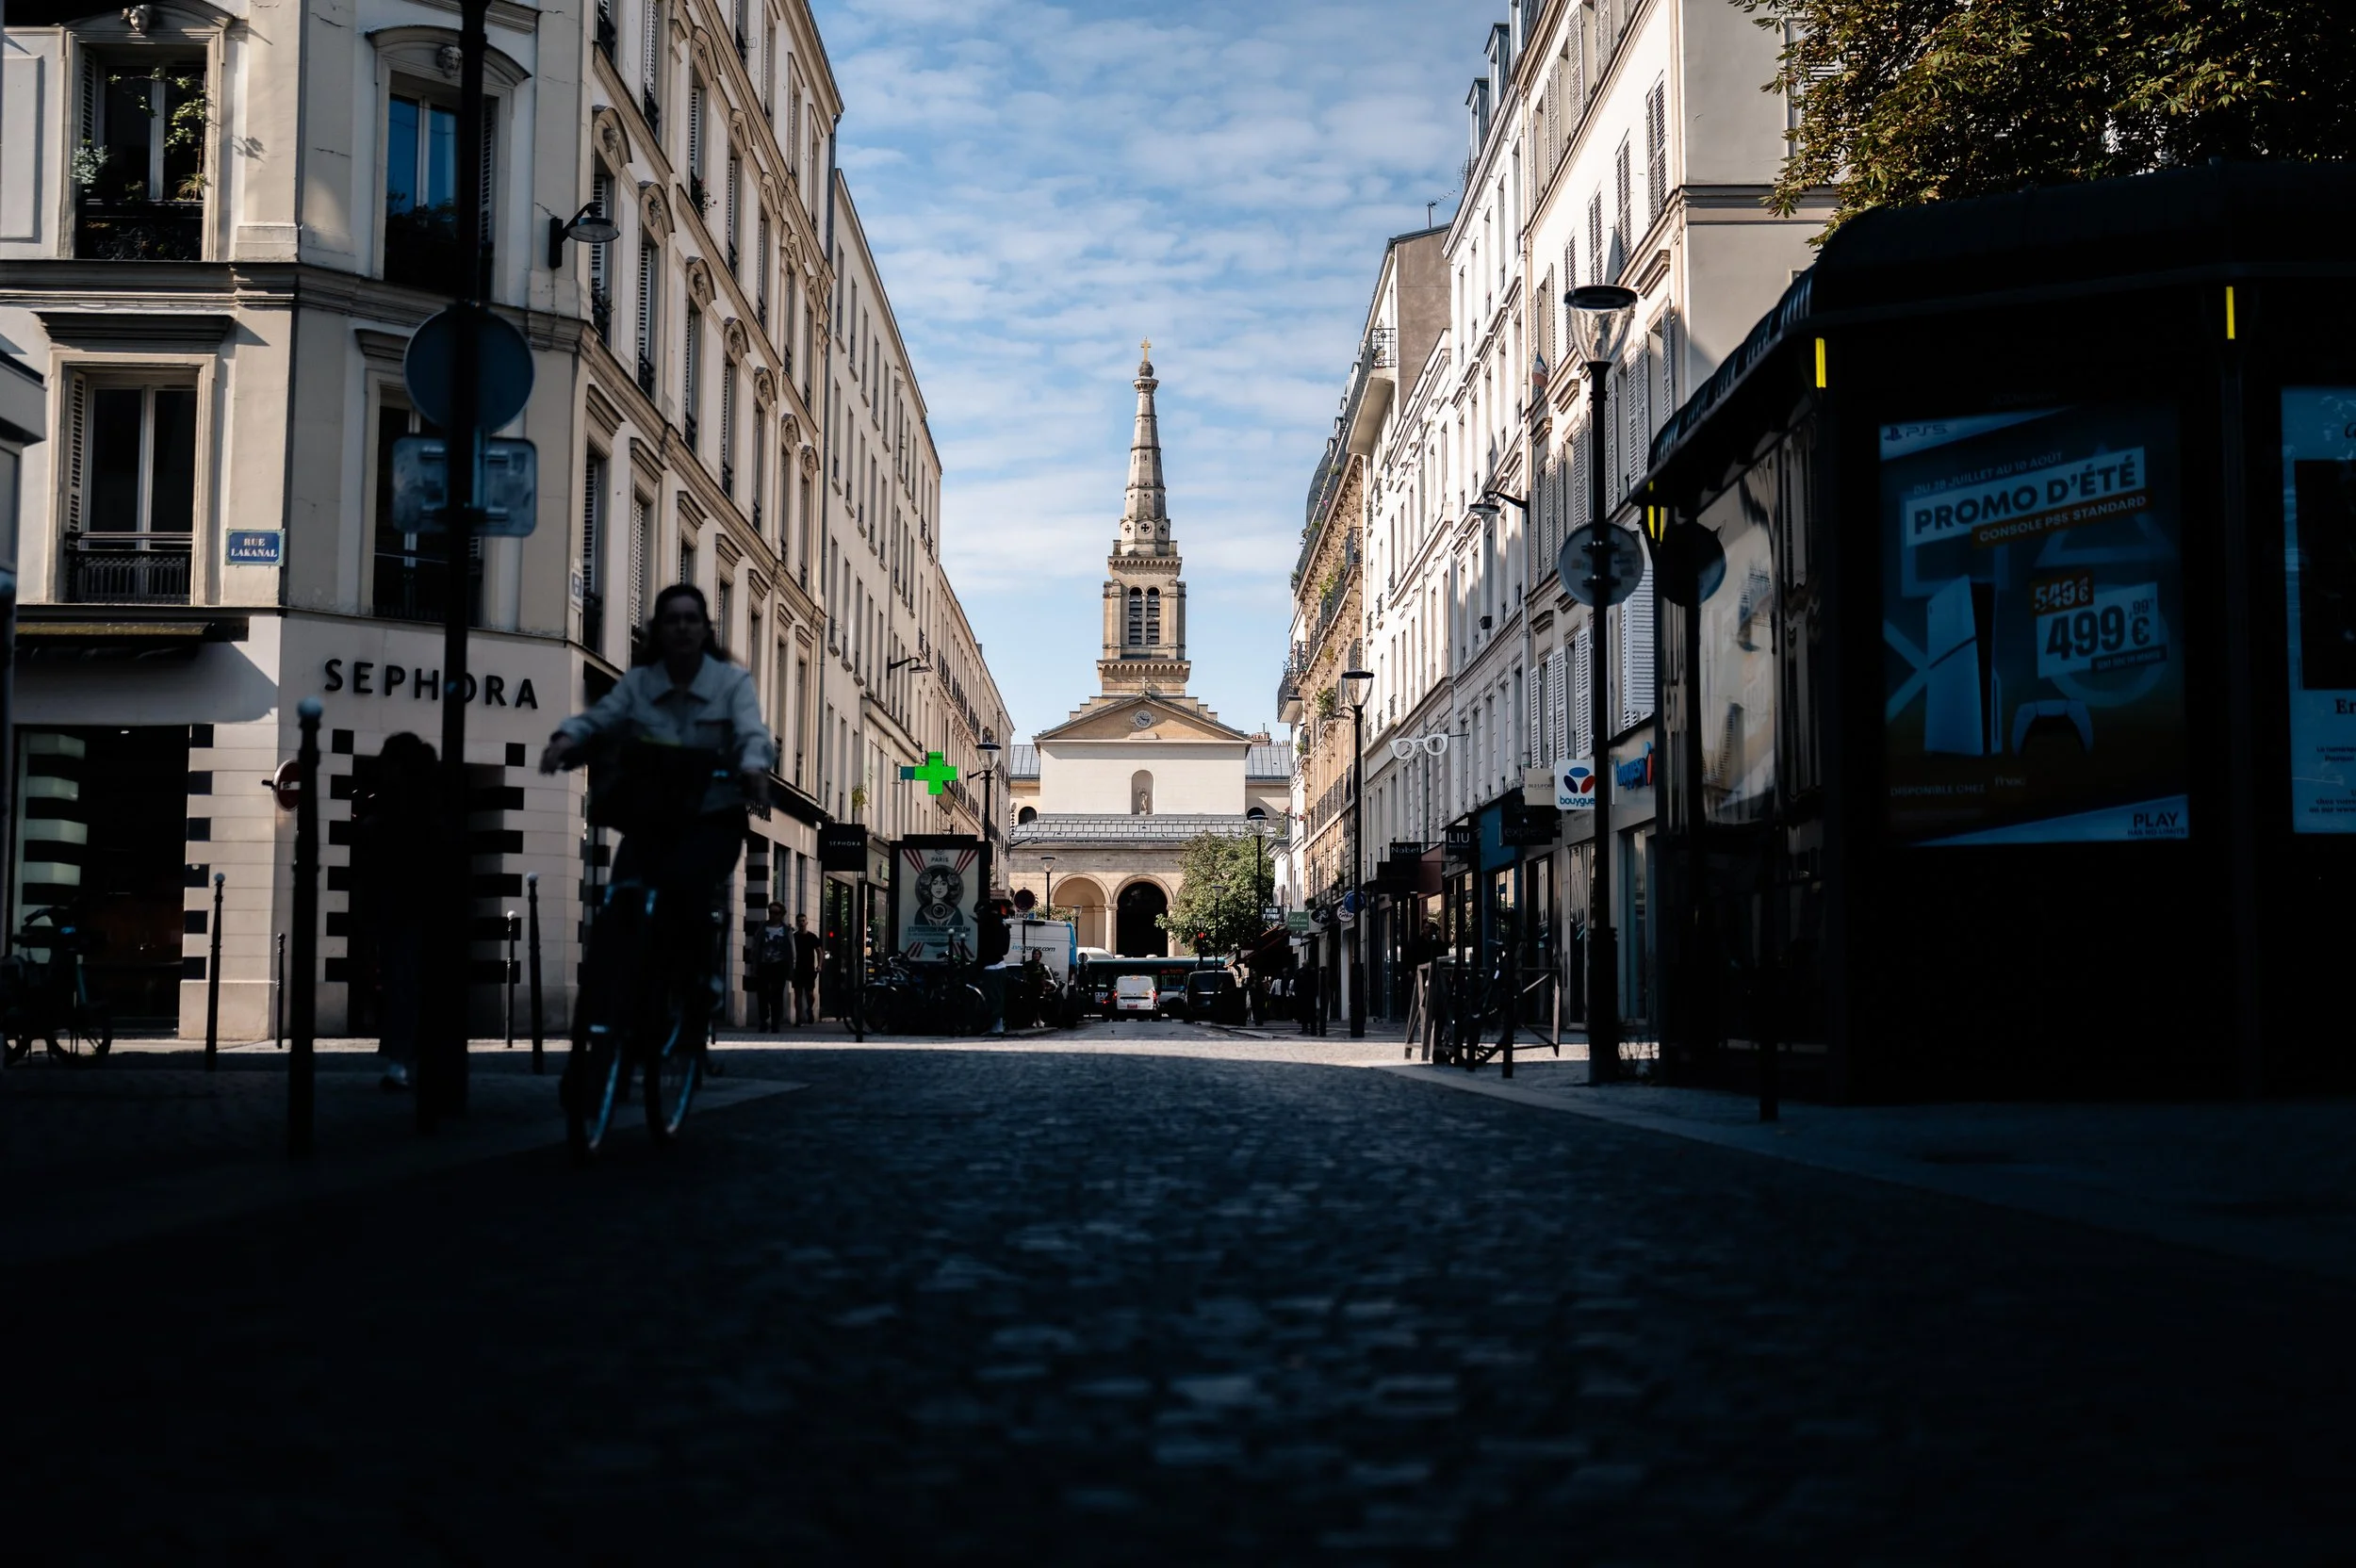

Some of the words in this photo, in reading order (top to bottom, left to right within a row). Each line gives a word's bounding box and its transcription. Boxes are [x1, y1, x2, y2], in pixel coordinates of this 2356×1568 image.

[1906, 424, 1949, 438] PS5
[1949, 468, 1994, 487] JUILLET
[1996, 464, 2012, 476] AU
[1914, 484, 2037, 534] PROMO
[2047, 454, 2136, 505] D'ÉTÉ
[1979, 516, 2042, 543] CONSOLE
[2045, 512, 2069, 528] PS5
[2072, 495, 2147, 521] STANDARD
[243, 537, 266, 547] RUE
[231, 548, 278, 558] LAKANAL
[1890, 784, 1953, 797] DISPONIBLE
[1955, 784, 1986, 794] CHEZ
[1560, 796, 1595, 807] bouygue
[2134, 811, 2179, 827] PLAY
[1448, 832, 1470, 843] LIU
